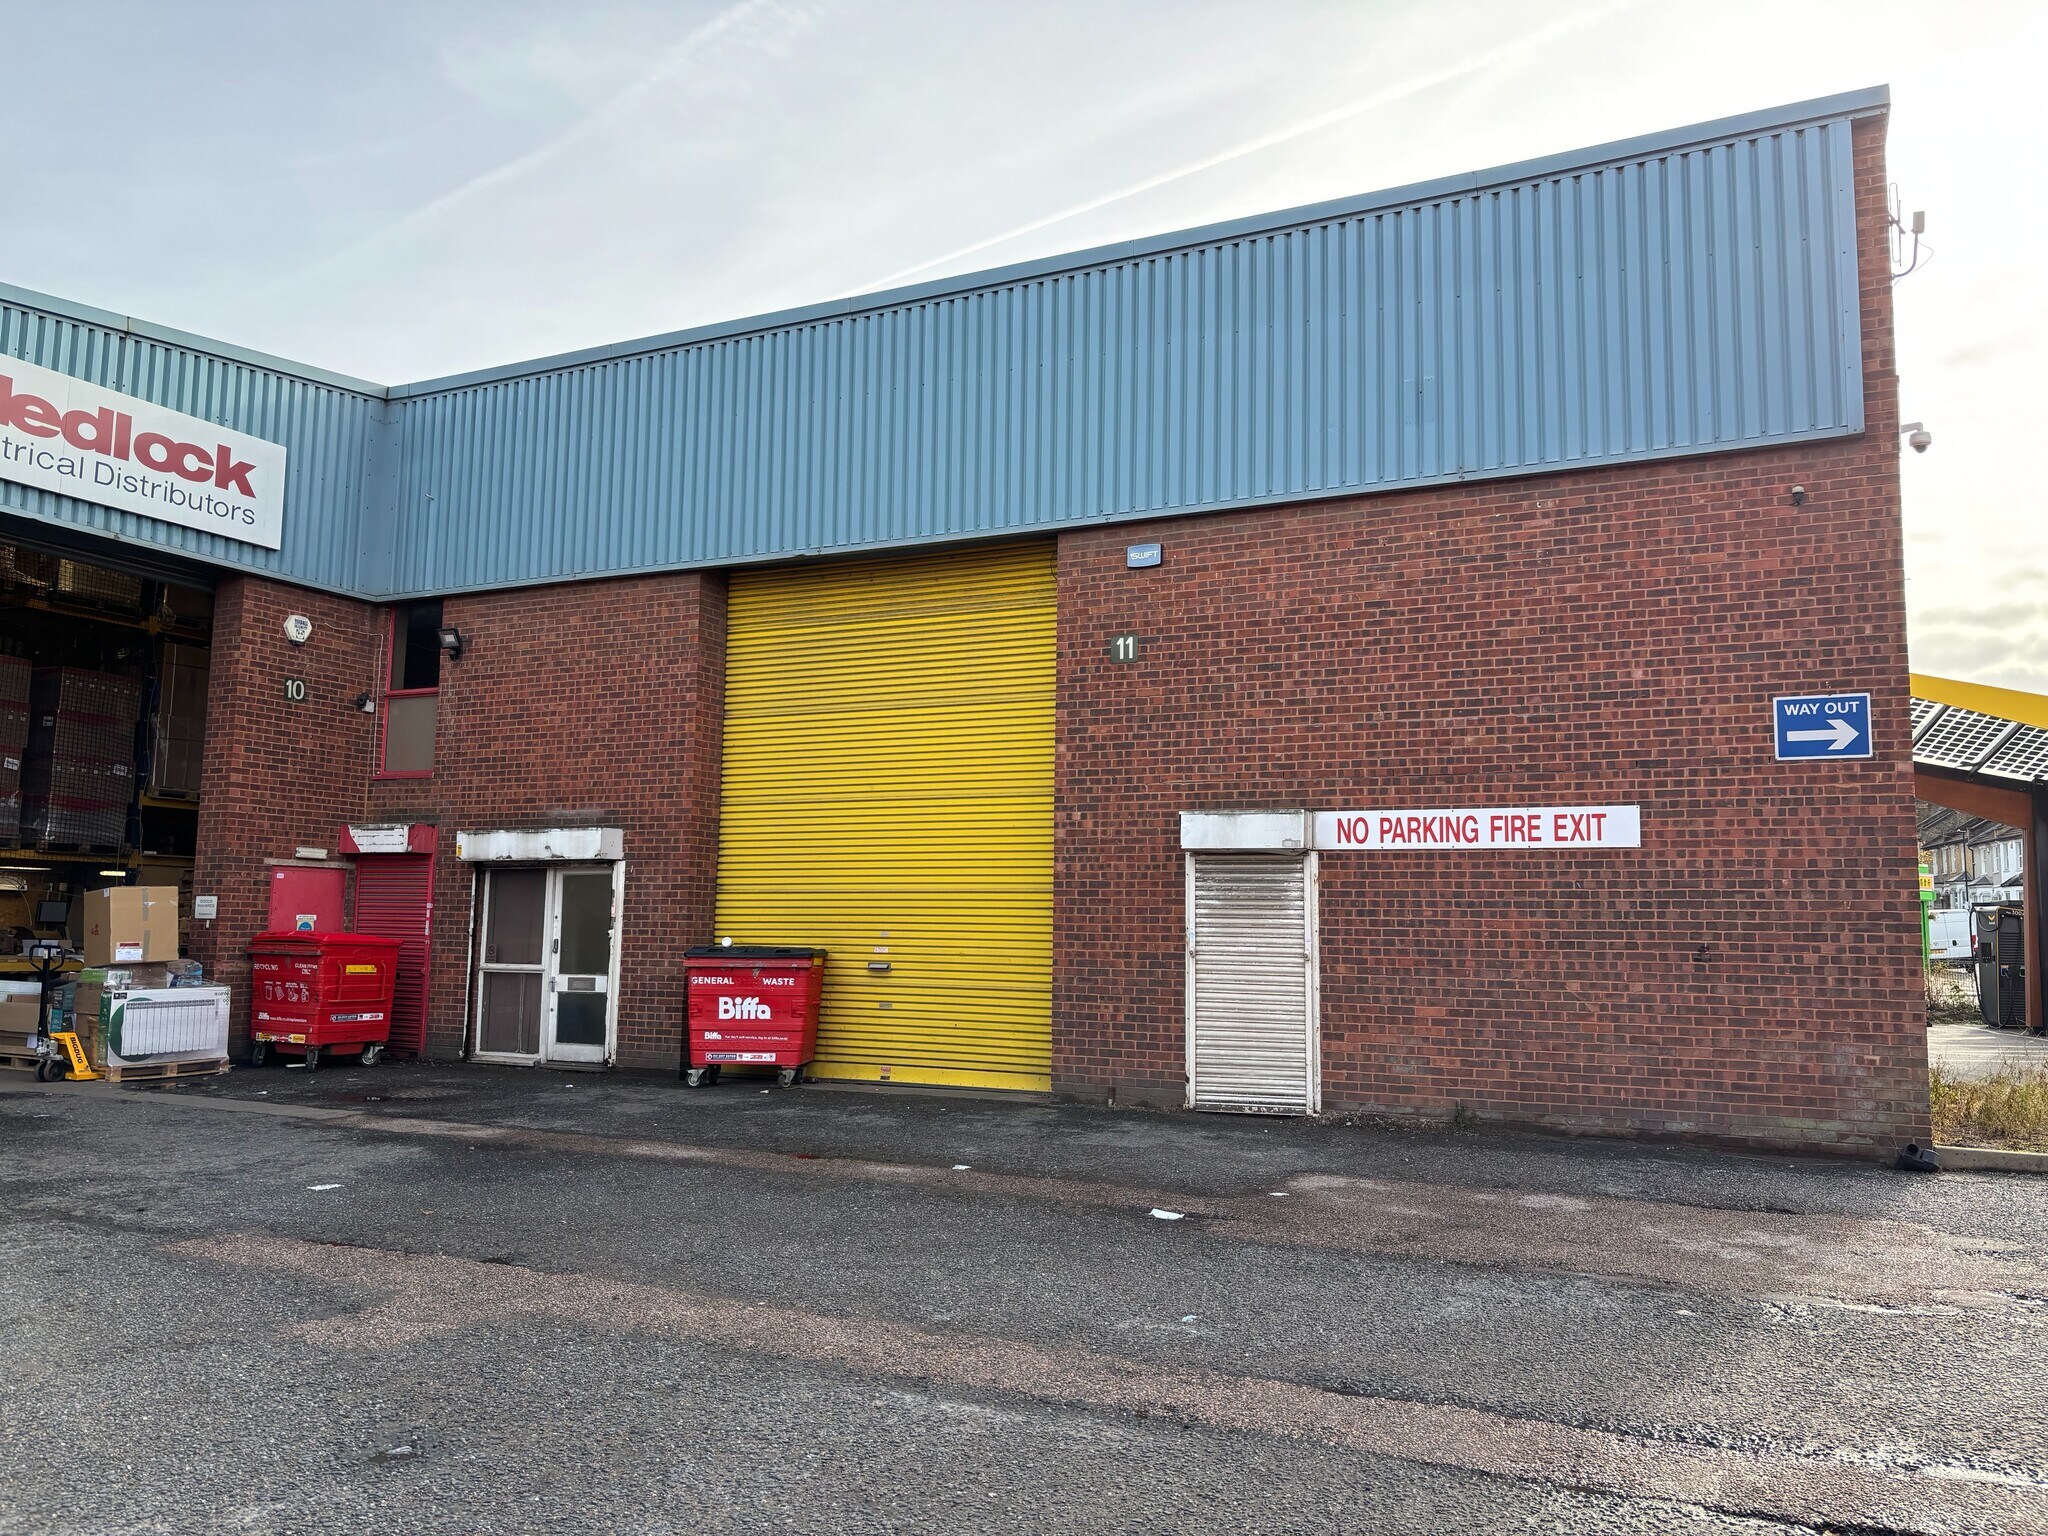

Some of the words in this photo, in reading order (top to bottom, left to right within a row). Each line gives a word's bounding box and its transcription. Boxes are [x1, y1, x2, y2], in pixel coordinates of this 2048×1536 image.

[0, 374, 257, 499] edlock
[94, 460, 256, 525] Distributors
[1130, 550, 1159, 560] SWIFT
[1116, 636, 1134, 660] 11
[286, 680, 305, 700] 10
[1784, 703, 1820, 716] WAY
[1824, 701, 1860, 714] OUT
[1336, 817, 1369, 844] NO
[1379, 815, 1479, 844] PARKING
[1490, 814, 1542, 843] FIRE
[1553, 813, 1607, 842] EXIT
[691, 976, 735, 985] GENERAL
[762, 977, 795, 986] WASTE
[718, 996, 772, 1020] Biffa
[704, 1031, 722, 1040] Biffa
[69, 1036, 84, 1064] BIGDUG
